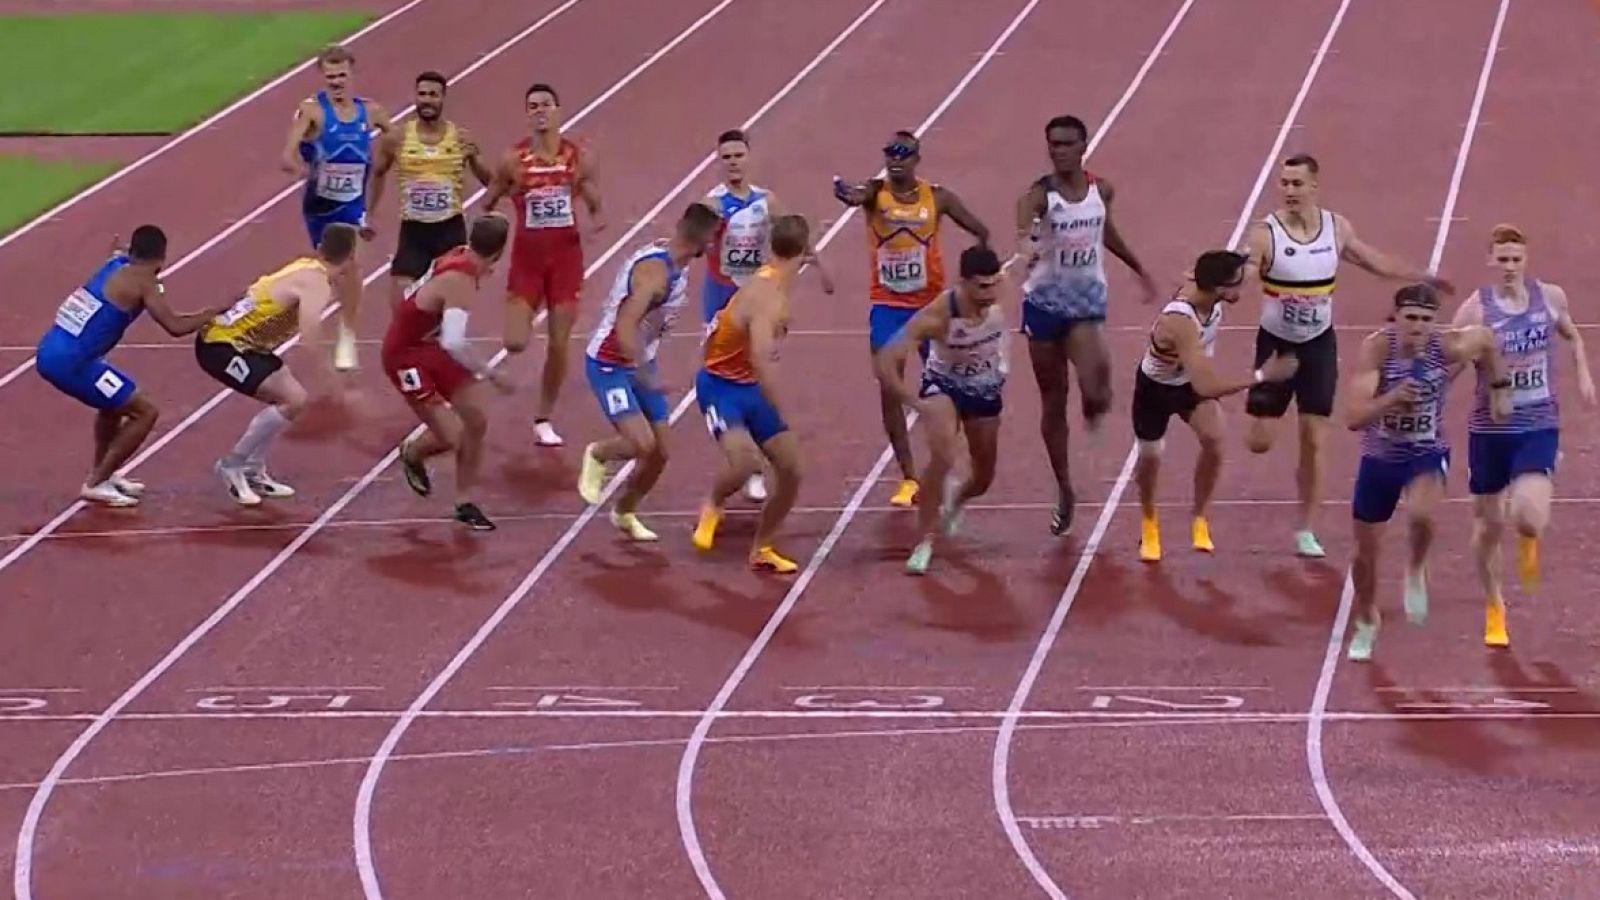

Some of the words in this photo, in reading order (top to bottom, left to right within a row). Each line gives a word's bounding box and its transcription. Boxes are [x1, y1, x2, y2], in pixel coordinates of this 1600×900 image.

[327, 176, 353, 188] ITA
[531, 200, 567, 216] ESP
[728, 249, 761, 265] CZE
[881, 263, 922, 281] NED
[1282, 305, 1322, 325] BEL
[233, 361, 244, 374] 7
[1384, 414, 1433, 433] GBR
[196, 695, 351, 708] 5
[494, 695, 641, 707] 4
[794, 695, 945, 708] 3
[1091, 695, 1245, 708] 2
